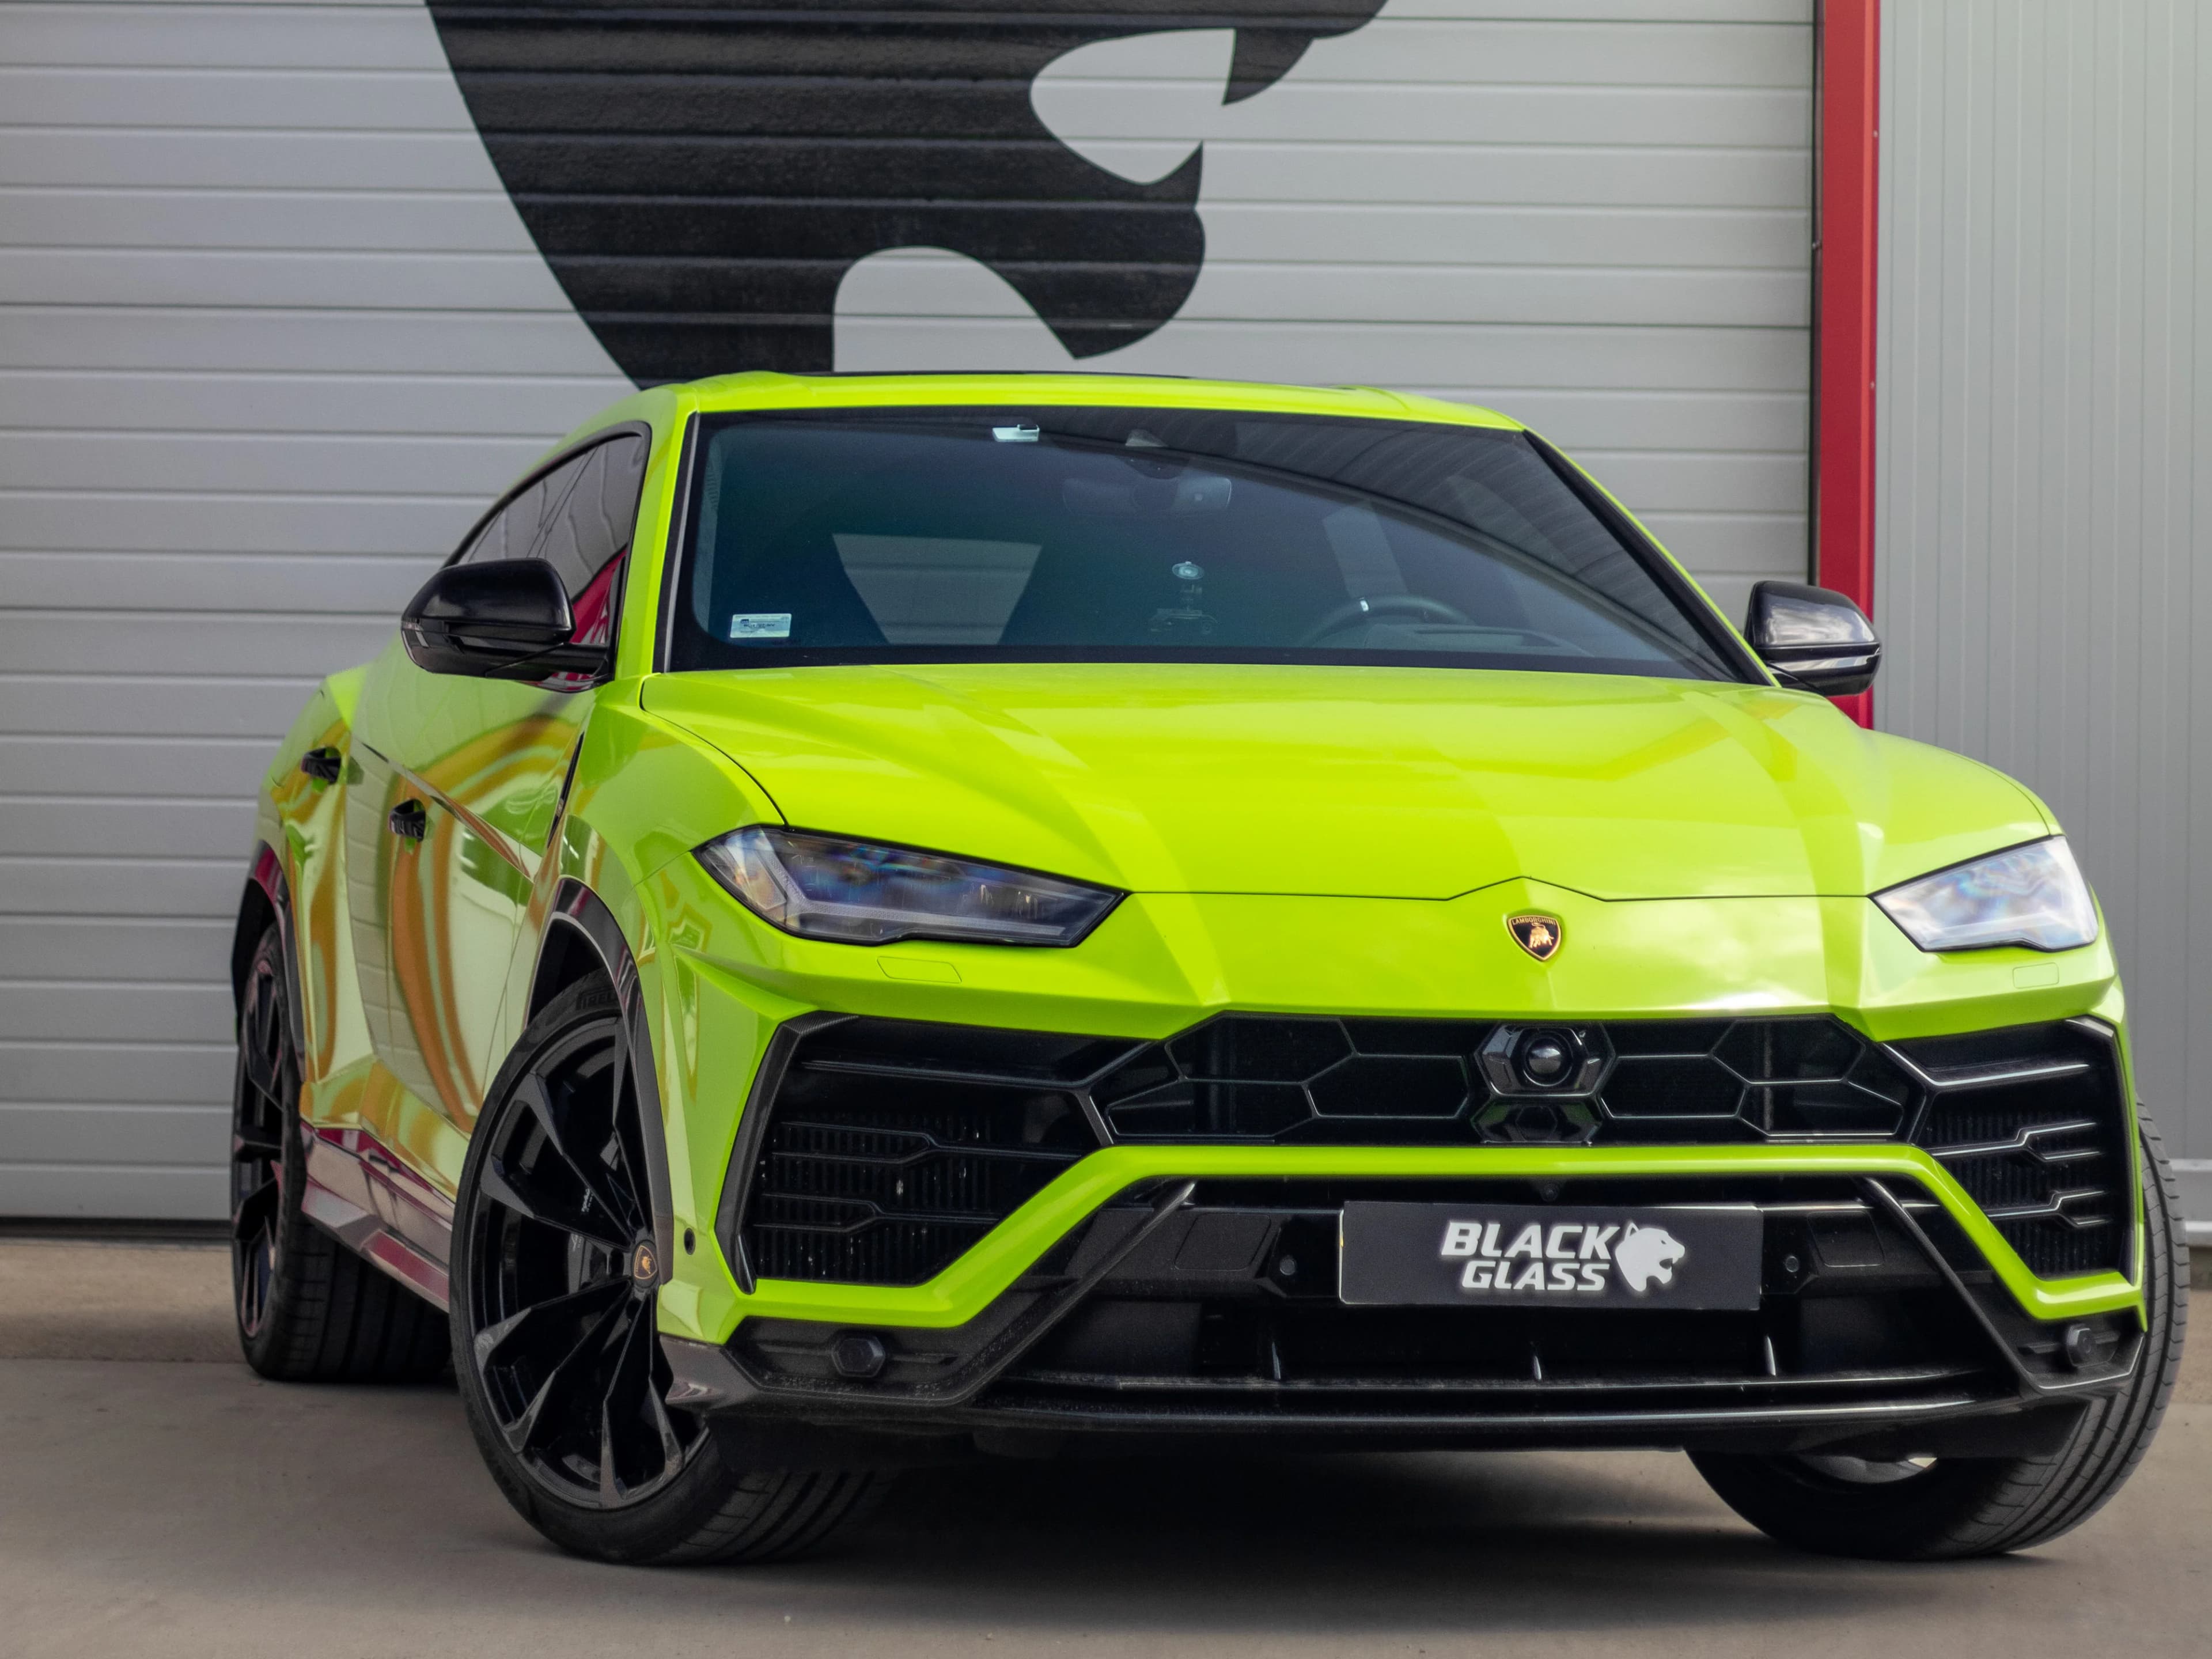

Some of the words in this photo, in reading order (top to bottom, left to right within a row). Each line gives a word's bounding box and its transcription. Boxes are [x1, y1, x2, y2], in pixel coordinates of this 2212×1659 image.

[1512, 916, 1556, 925] LAMBORGHINI
[575, 986, 616, 1010] PIREL
[1441, 1222, 1620, 1259] BLACK
[1462, 1260, 1609, 1291] GLASS
